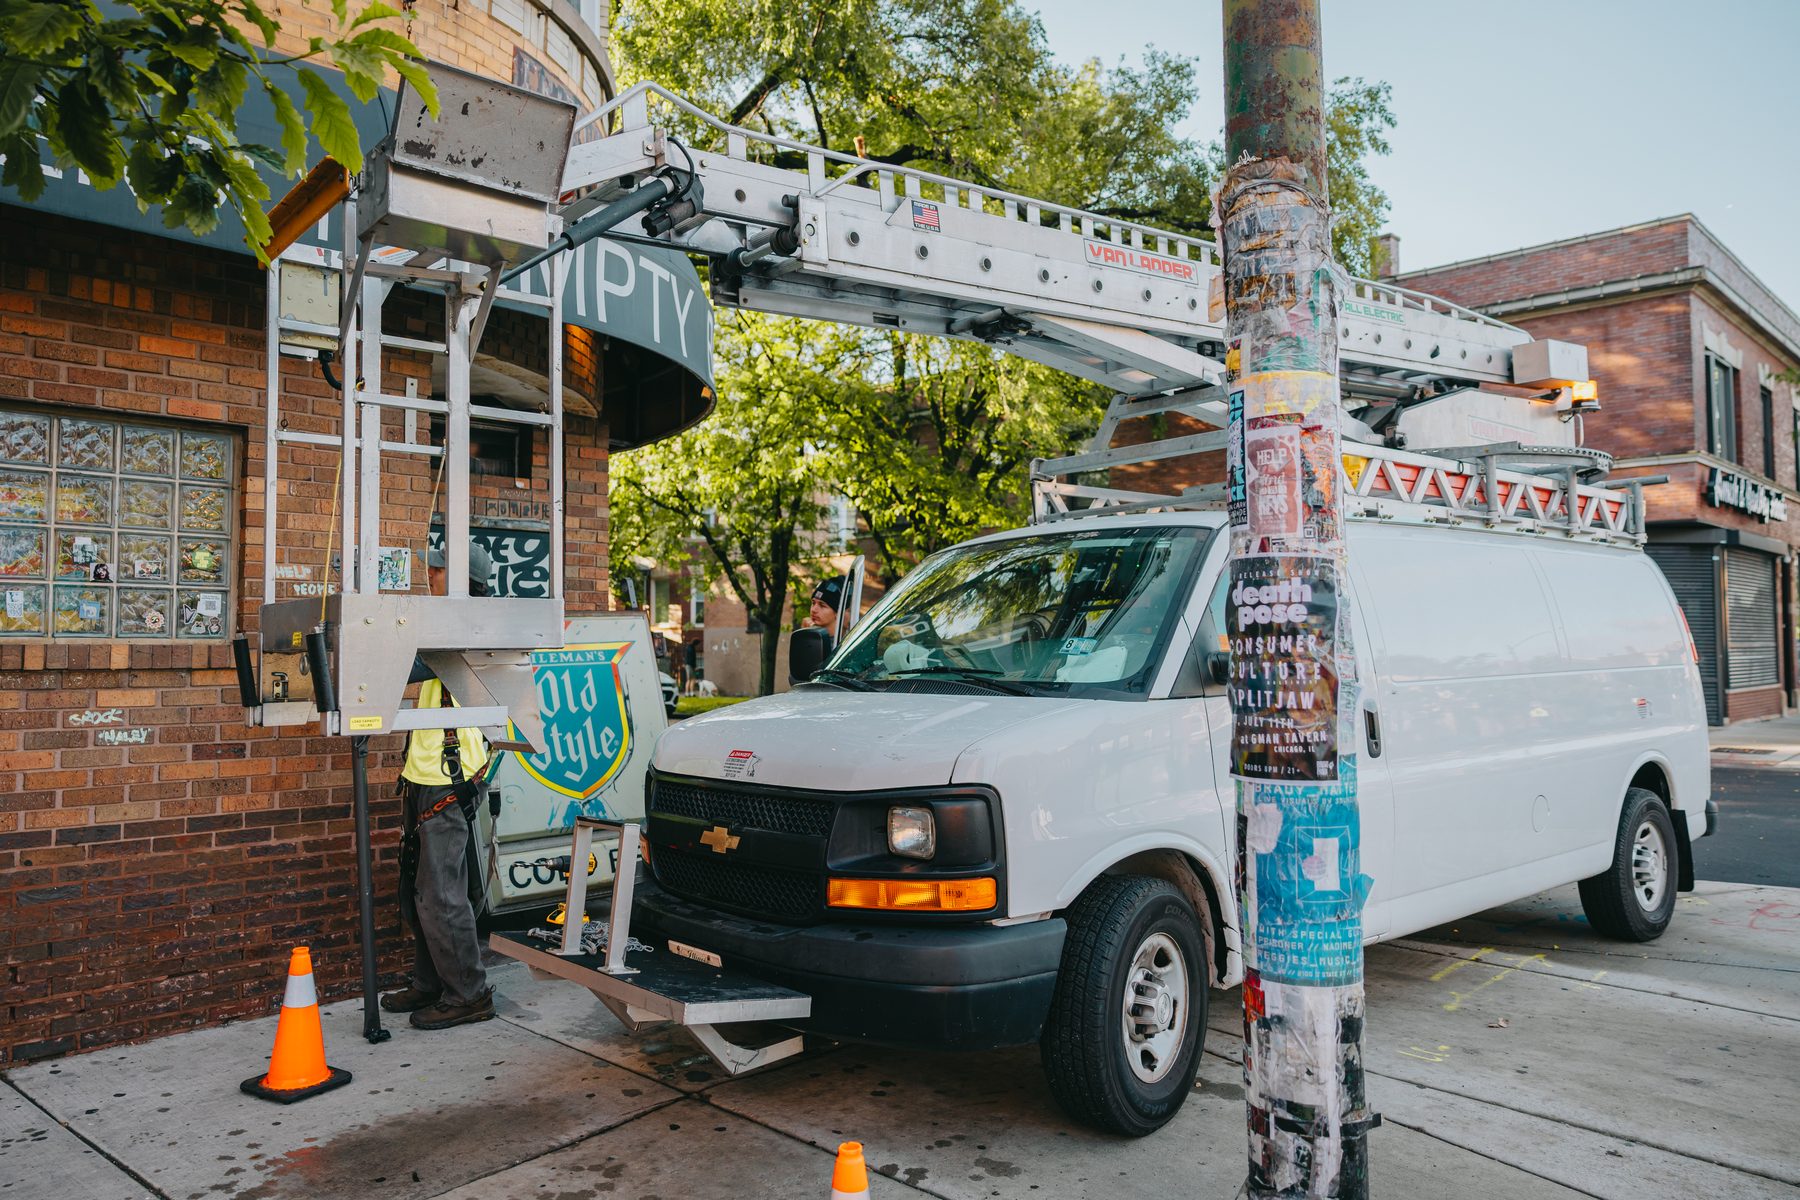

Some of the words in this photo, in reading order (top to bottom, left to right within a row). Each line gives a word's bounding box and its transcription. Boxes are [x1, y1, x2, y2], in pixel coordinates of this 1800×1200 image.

[1089, 243, 1127, 267] VAN
[1129, 253, 1194, 281] LADDER
[498, 237, 694, 358] MPTY
[1344, 302, 1362, 314] ALL
[1363, 305, 1404, 323] ELECTRIC
[1256, 448, 1287, 466] HELP
[1232, 577, 1312, 607] death
[1238, 603, 1308, 632] pose
[1230, 634, 1317, 656] CONSUMER
[531, 651, 606, 664] ILEMAN'S
[1229, 661, 1321, 680] CULTURE
[537, 668, 598, 718] Old
[1243, 715, 1264, 727] JULY
[1284, 730, 1327, 743] TAVERN
[1292, 930, 1342, 940] SPECIAL
